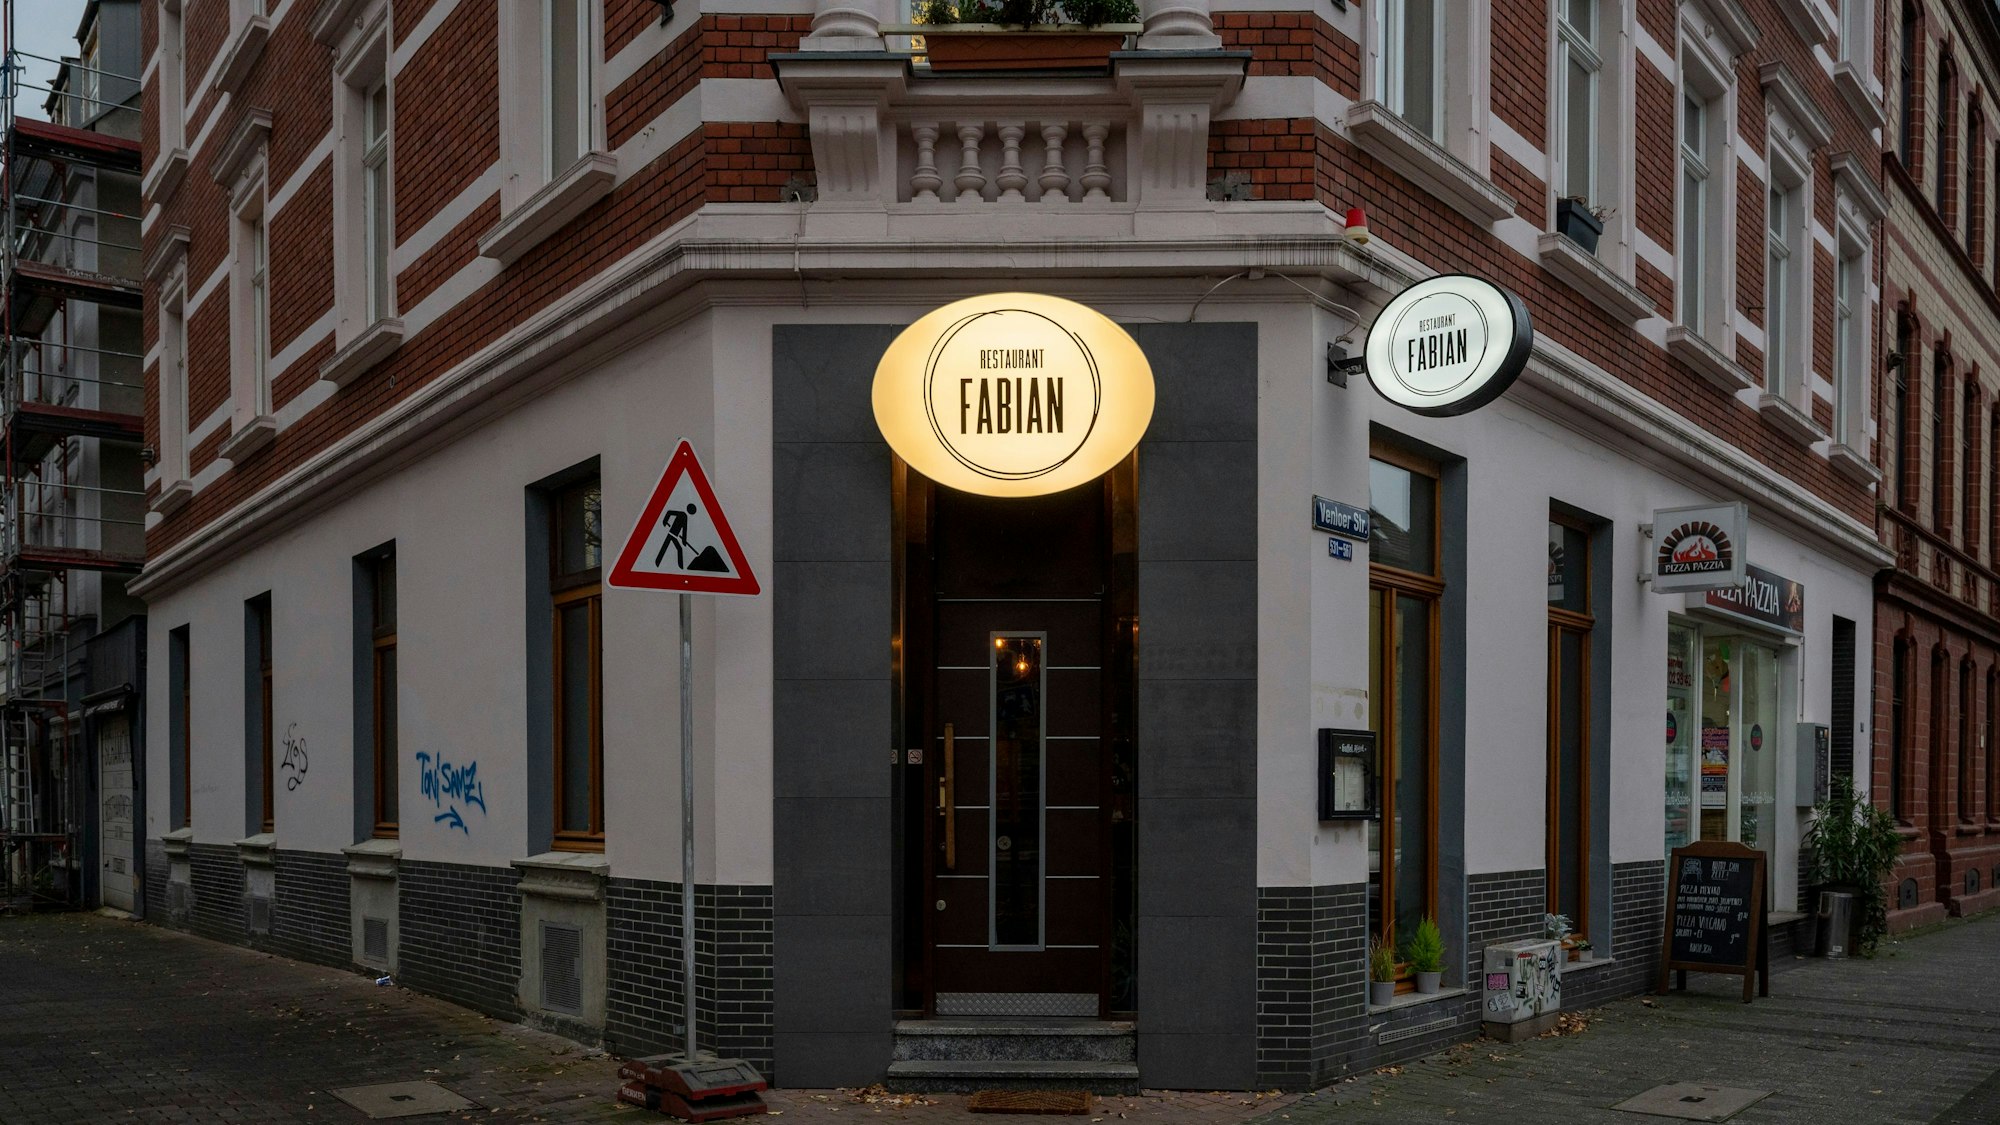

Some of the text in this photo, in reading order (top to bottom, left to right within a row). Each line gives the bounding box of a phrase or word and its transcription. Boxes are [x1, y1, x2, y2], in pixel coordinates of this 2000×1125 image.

[1419, 313, 1456, 333] RESTAURANT
[980, 349, 1044, 369] RESTAURANT
[1408, 328, 1467, 373] FABIAN
[960, 377, 1064, 434] FABIAN
[1320, 502, 1367, 534] Venloer Str.
[1665, 560, 1725, 574] PIZZA PAZZIA
[1745, 575, 1779, 616] PAZZIA
[1680, 884, 1698, 894] PIZZA
[1676, 914, 1696, 928] PIZZA
